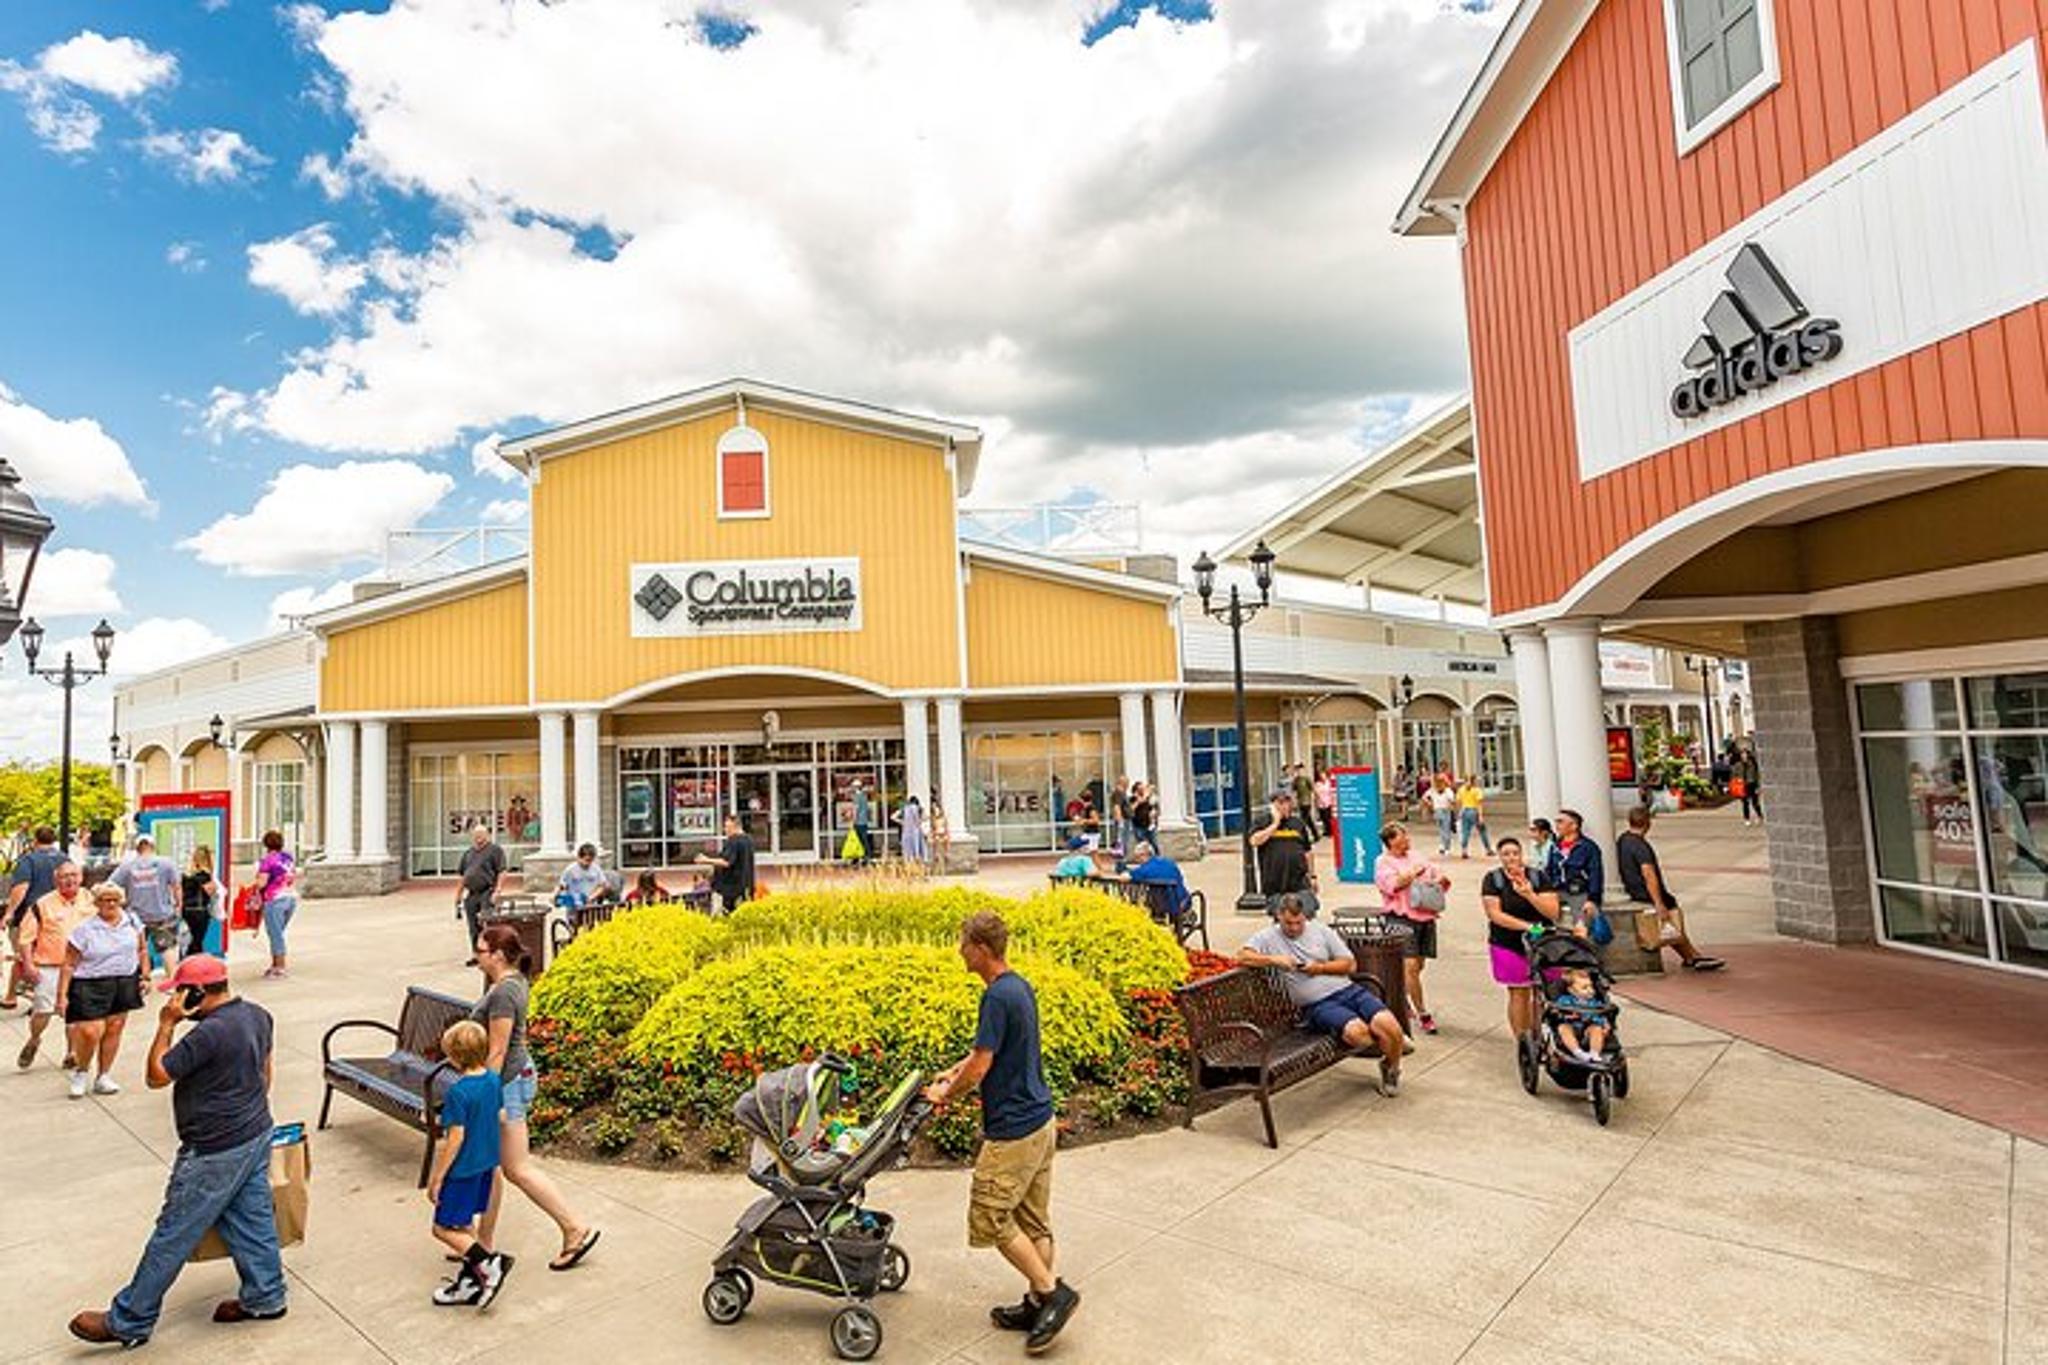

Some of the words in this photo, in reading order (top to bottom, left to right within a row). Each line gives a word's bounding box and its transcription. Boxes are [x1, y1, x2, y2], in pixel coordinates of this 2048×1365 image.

[1670, 317, 1844, 418] adidas
[685, 567, 856, 606] Columbia
[776, 602, 854, 623] Company
[985, 794, 1039, 814] SALE
[1933, 801, 1970, 820] sale
[679, 813, 711, 829] SALE
